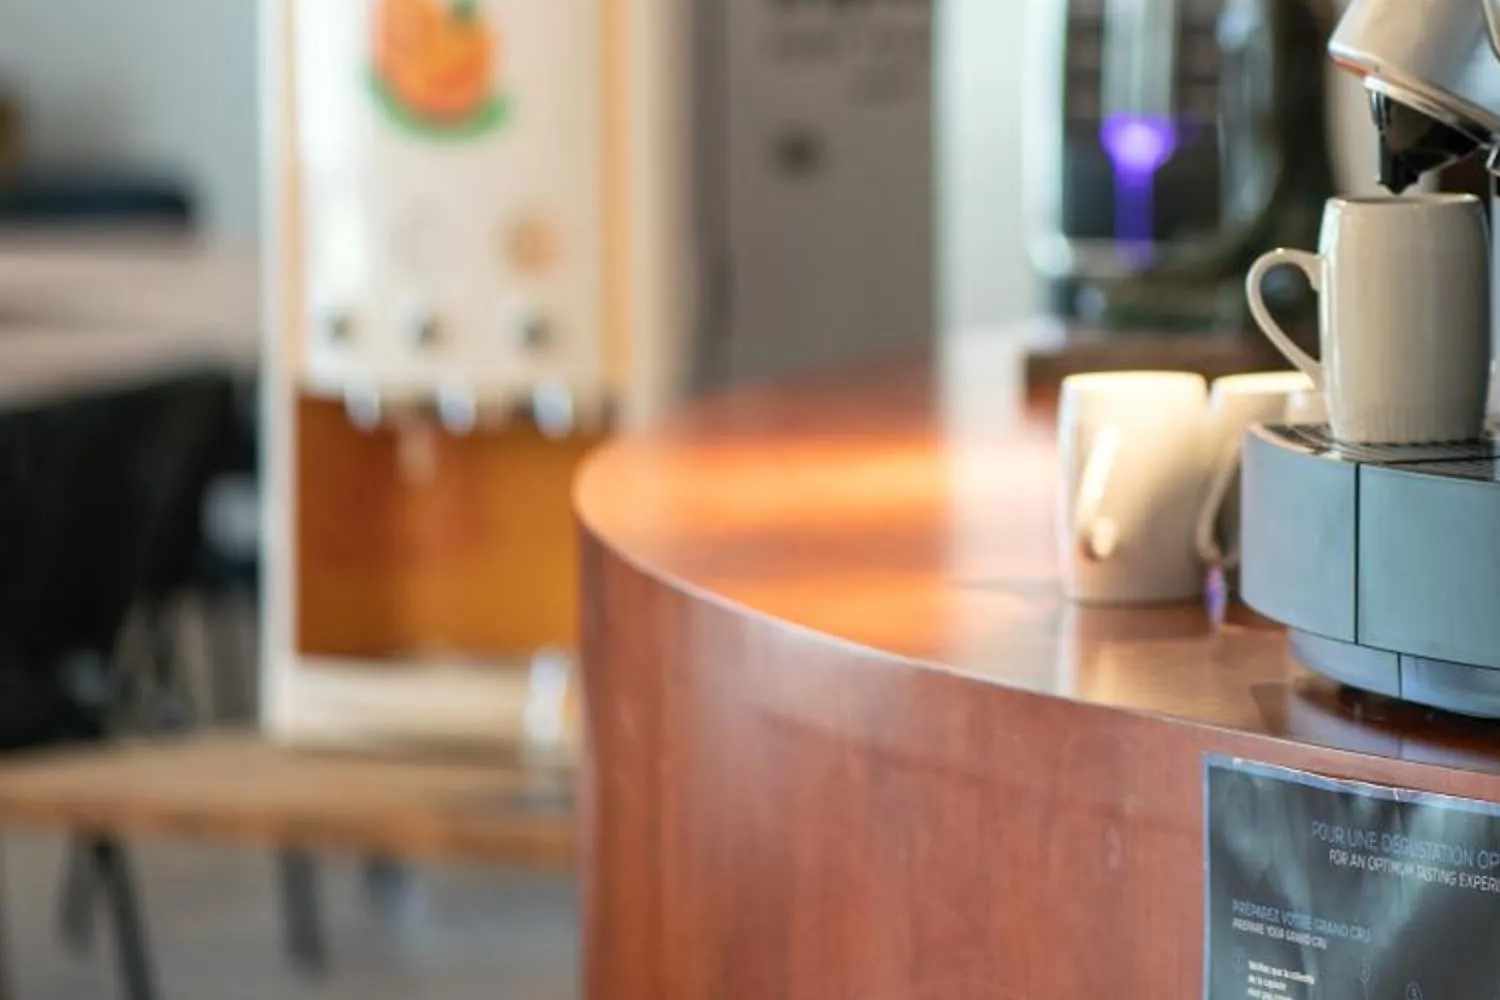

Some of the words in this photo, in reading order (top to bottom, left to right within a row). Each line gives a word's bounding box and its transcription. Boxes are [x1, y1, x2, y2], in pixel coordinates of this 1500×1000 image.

[1311, 821, 1345, 845] POUR
[1347, 827, 1377, 850] UNE
[1329, 849, 1348, 866] FOR
[1349, 853, 1366, 870] AN
[1416, 864, 1456, 886] TASTING
